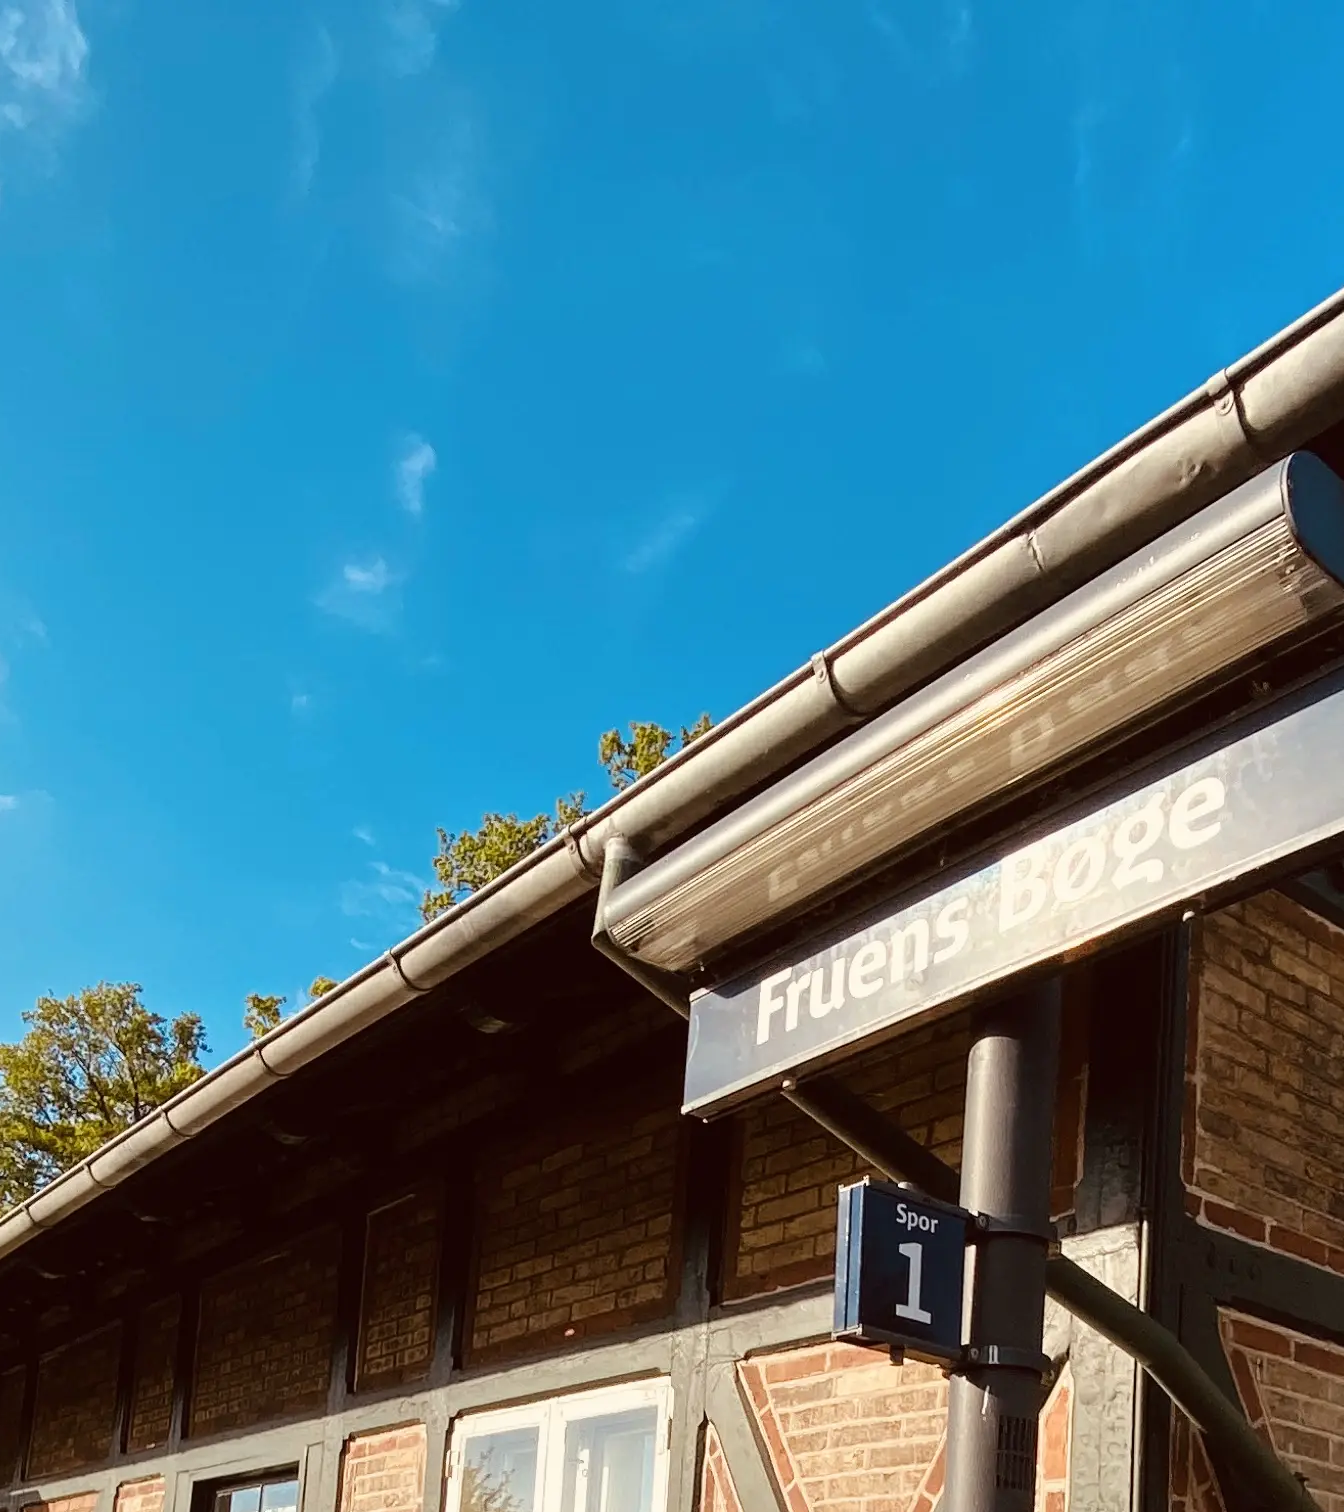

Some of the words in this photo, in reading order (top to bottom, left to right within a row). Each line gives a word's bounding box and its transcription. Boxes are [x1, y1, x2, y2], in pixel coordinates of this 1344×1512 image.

[755, 896, 971, 1046] Fruens
[997, 775, 1227, 935] Bøge
[895, 1202, 939, 1234] Spor
[895, 1241, 932, 1326] 1
